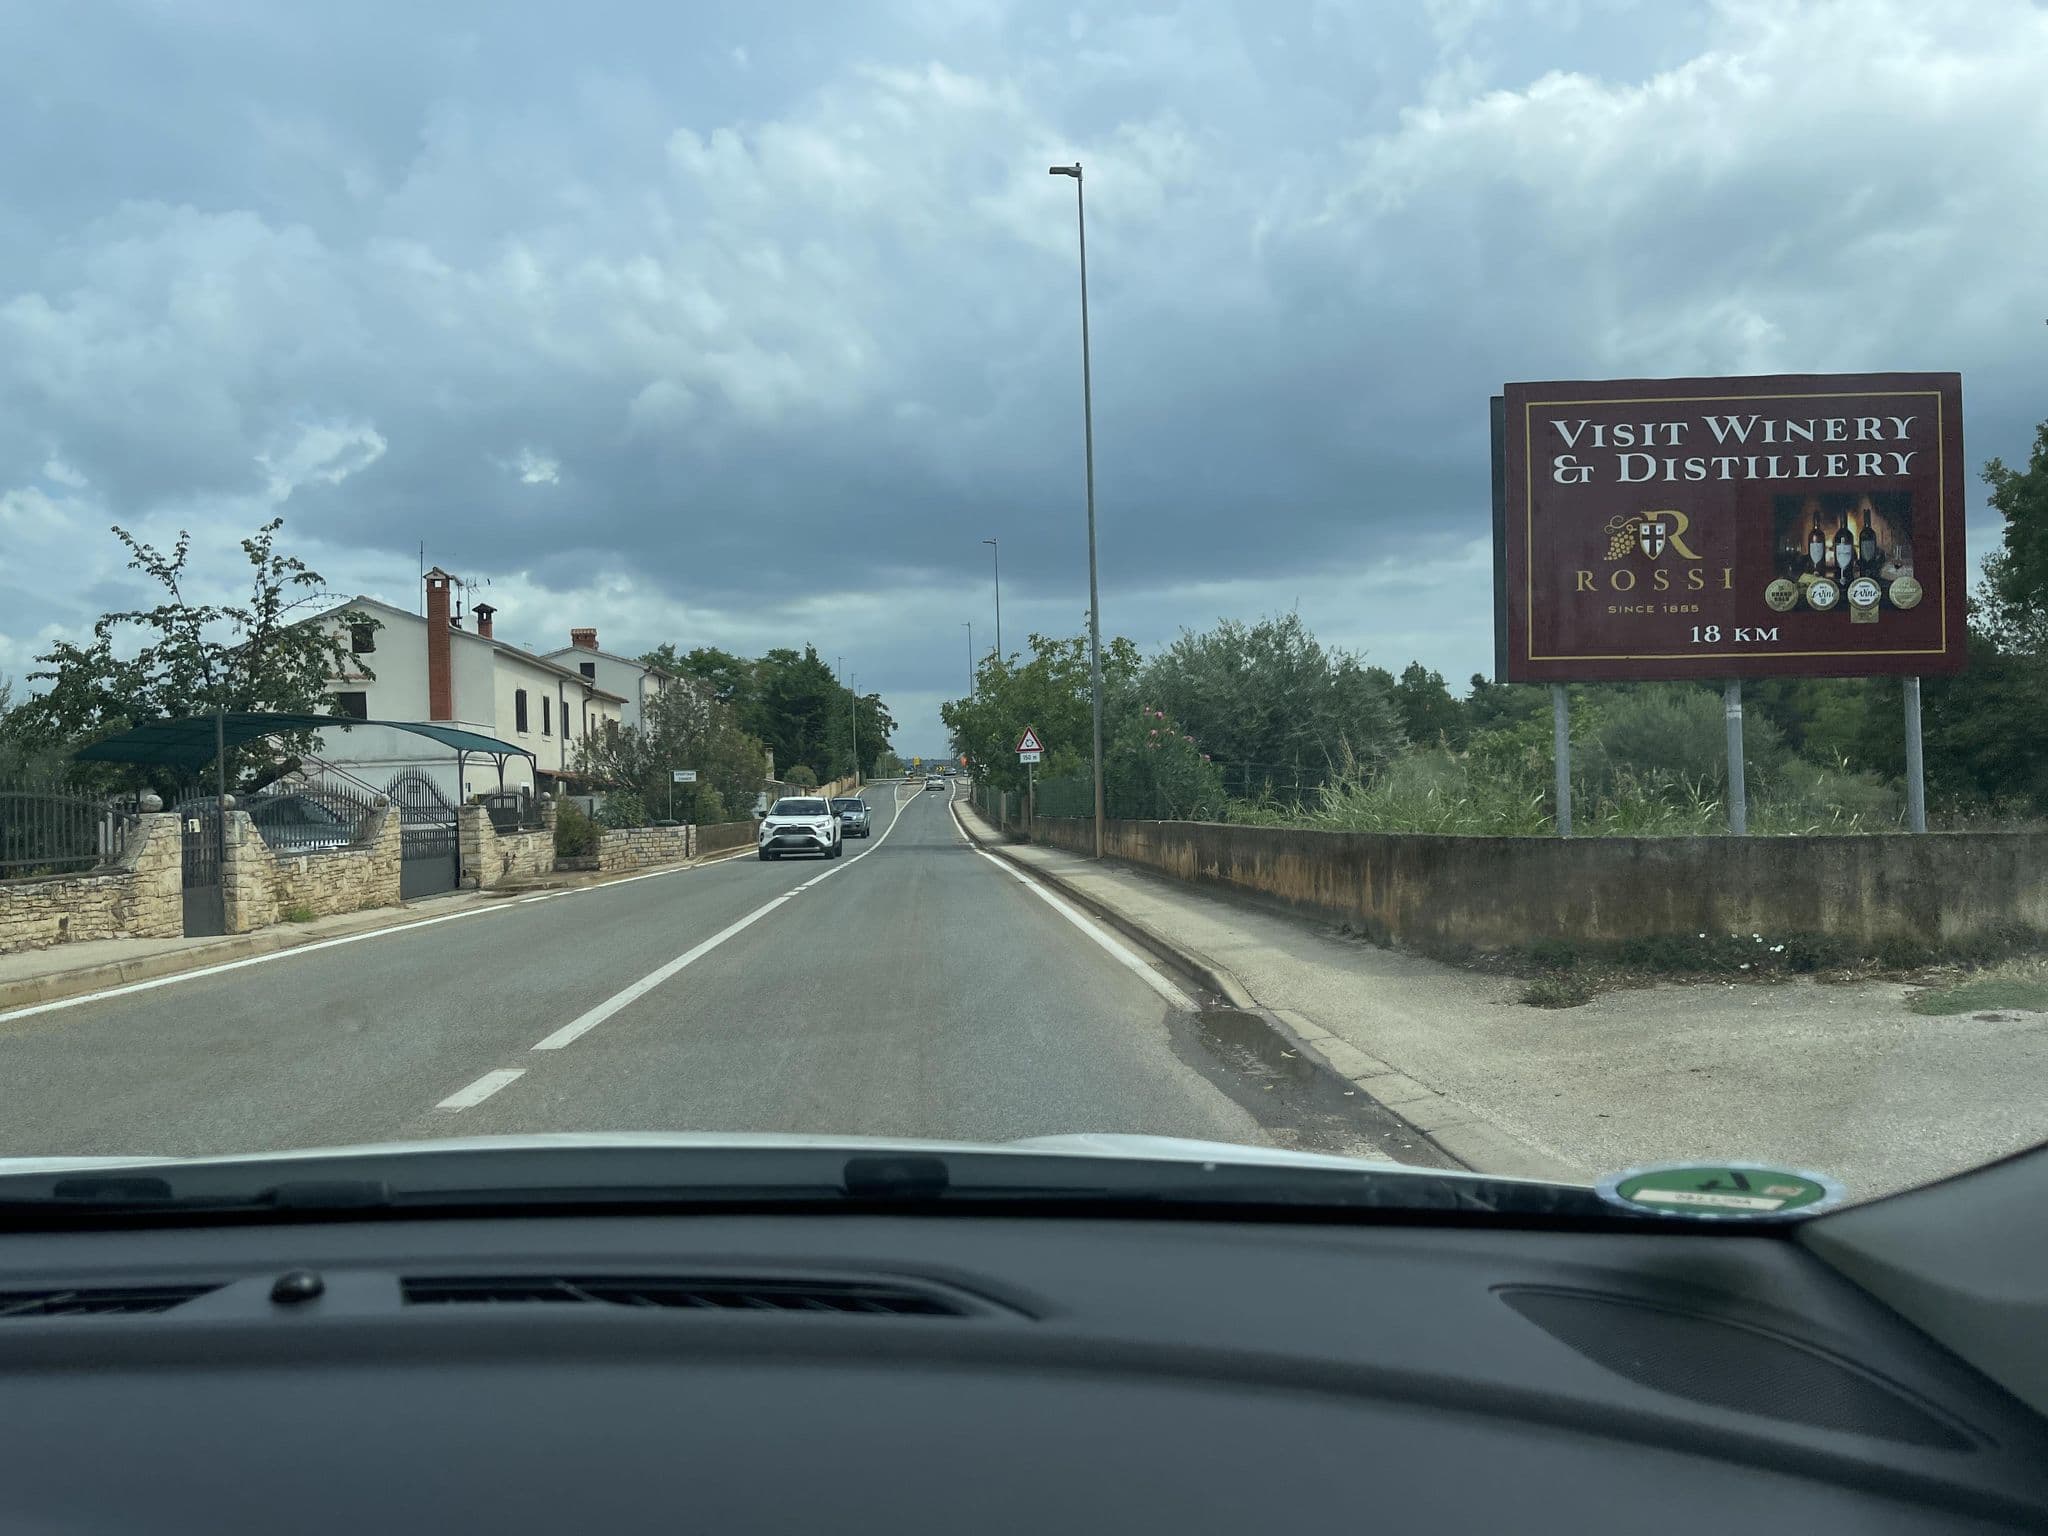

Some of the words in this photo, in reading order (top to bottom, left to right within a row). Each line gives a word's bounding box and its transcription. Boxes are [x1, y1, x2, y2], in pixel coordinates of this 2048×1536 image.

[1550, 418, 1689, 448] VISIT
[1702, 414, 1918, 444] WINERY
[1553, 454, 1595, 484] &
[1615, 451, 1918, 483] DISTILLERY
[1576, 567, 1734, 592] ROSSI
[1608, 605, 1655, 614] SINCE
[1663, 604, 1700, 613] 1885
[1690, 625, 1721, 643] 18
[1734, 627, 1780, 642] KM
